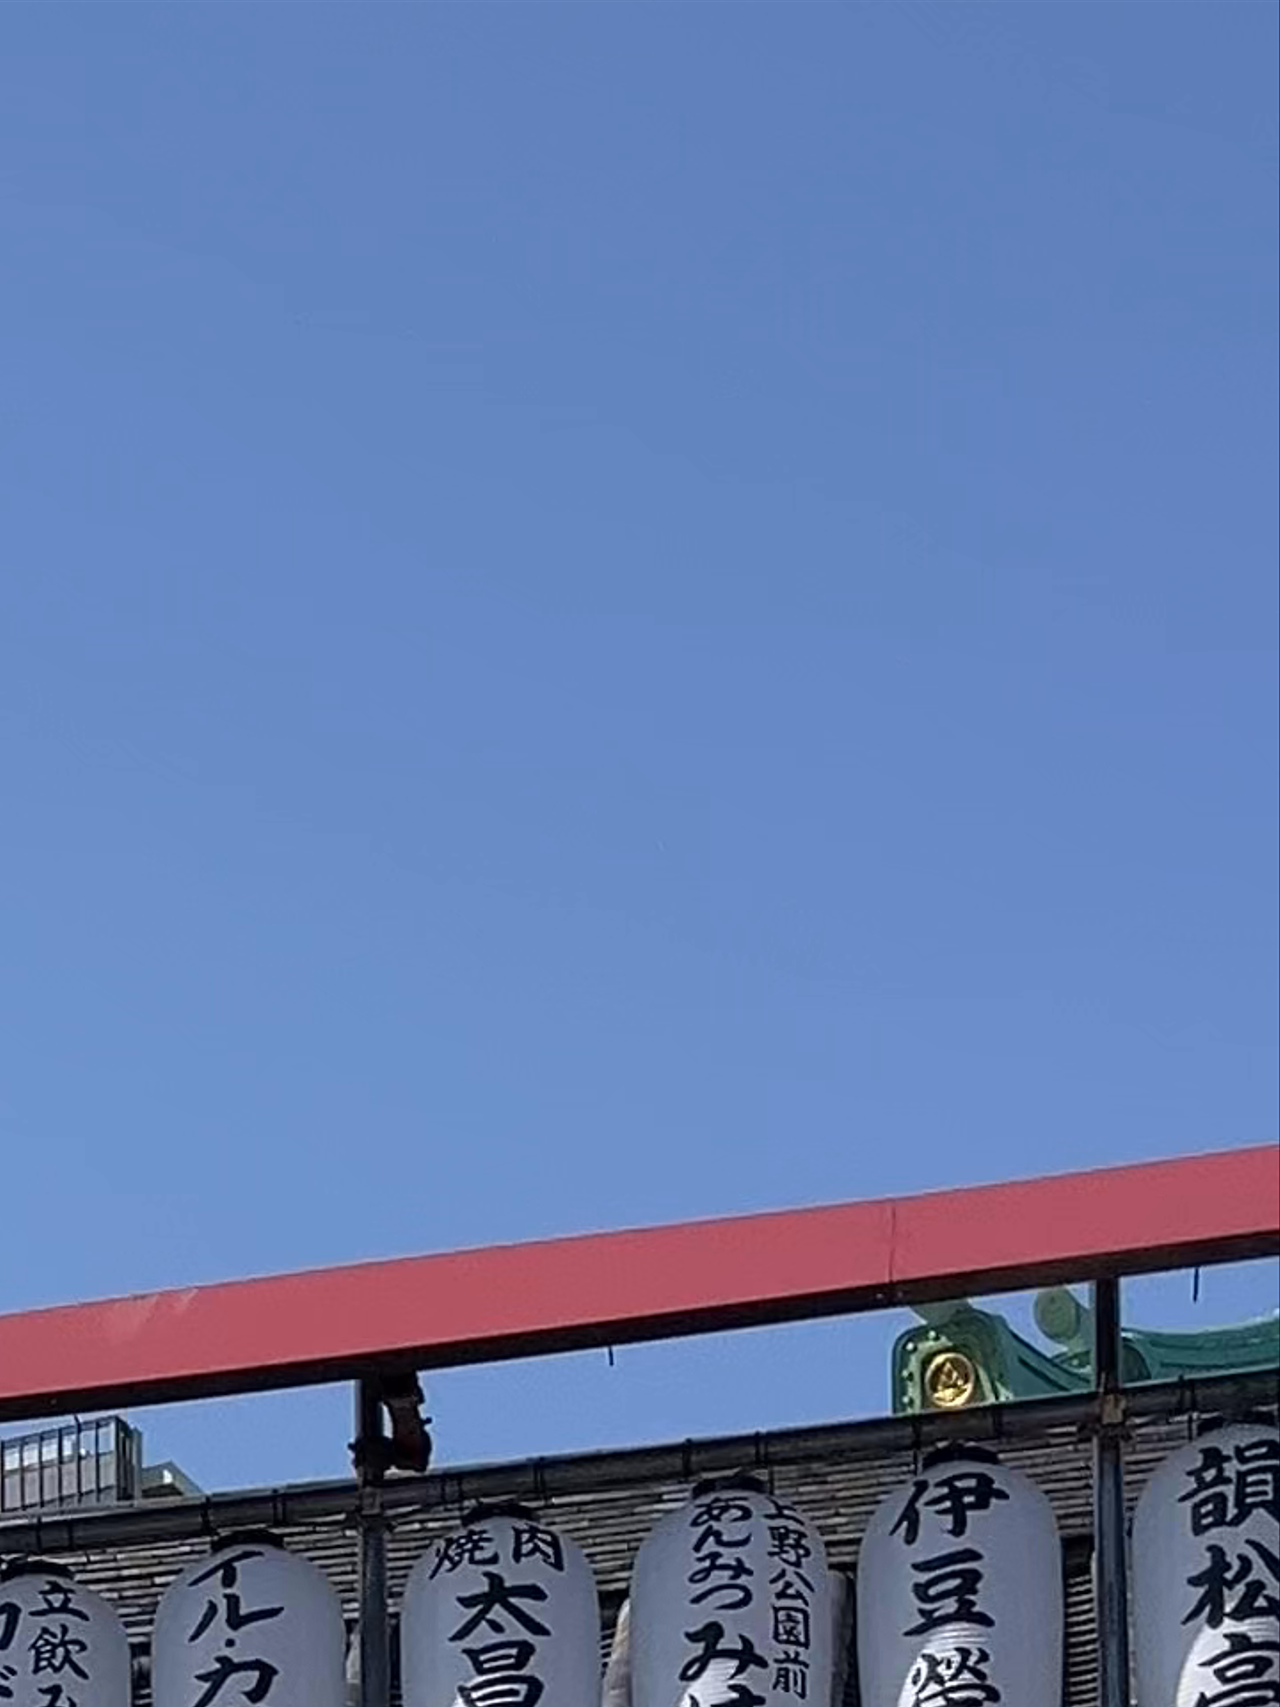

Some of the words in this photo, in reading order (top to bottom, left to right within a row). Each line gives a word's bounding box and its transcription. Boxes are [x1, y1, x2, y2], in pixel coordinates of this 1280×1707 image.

[429, 1523, 565, 1580] 焼肉
[766, 1495, 812, 1701] 上野公園前
